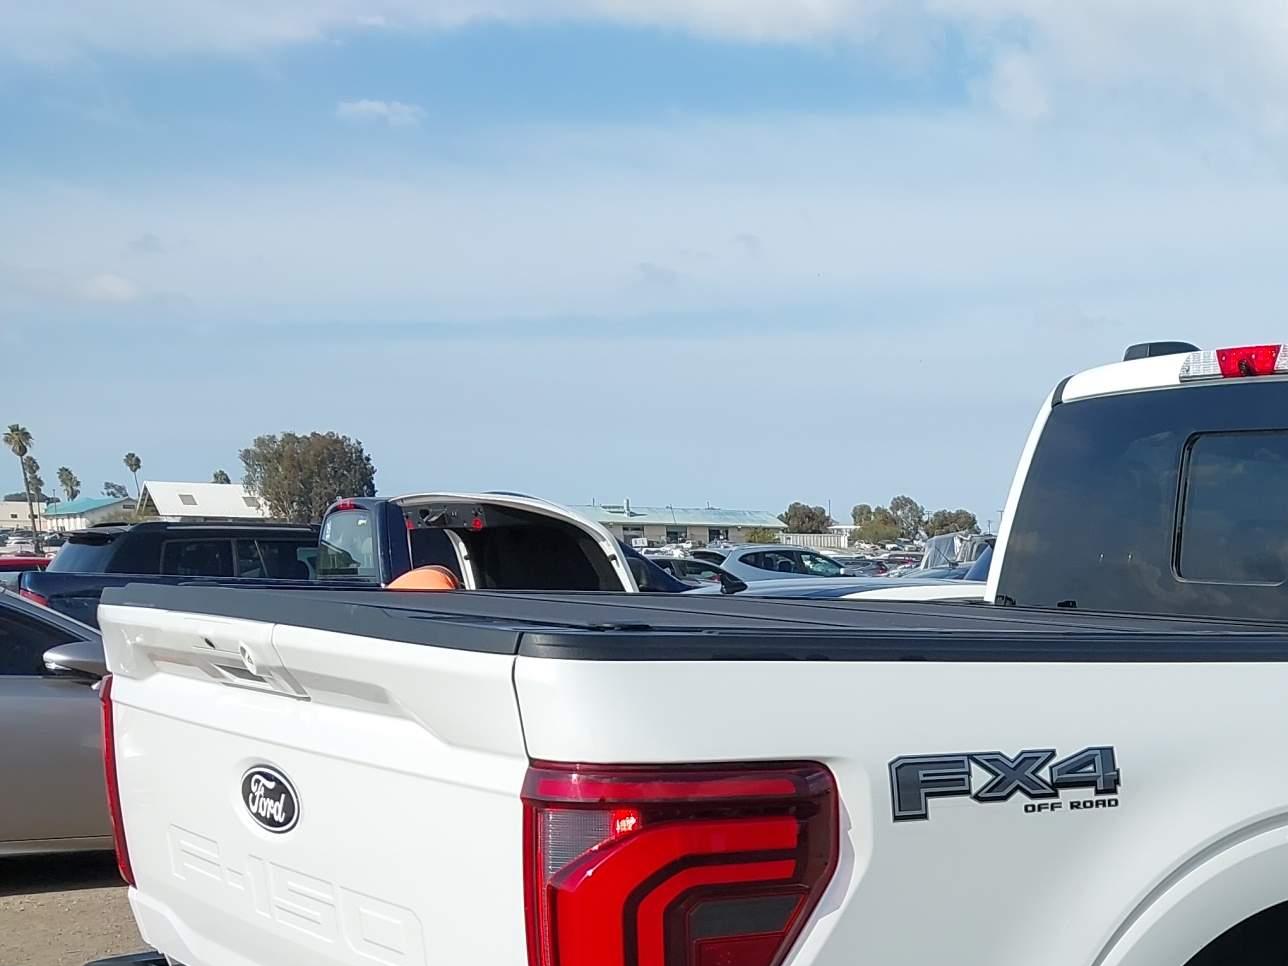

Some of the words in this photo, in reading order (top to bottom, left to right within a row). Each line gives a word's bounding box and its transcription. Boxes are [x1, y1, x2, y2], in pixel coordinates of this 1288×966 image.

[248, 774, 286, 823] Ford
[888, 746, 1120, 823] FX4
[1024, 802, 1062, 813] OFF
[1069, 798, 1119, 810] ROAD
